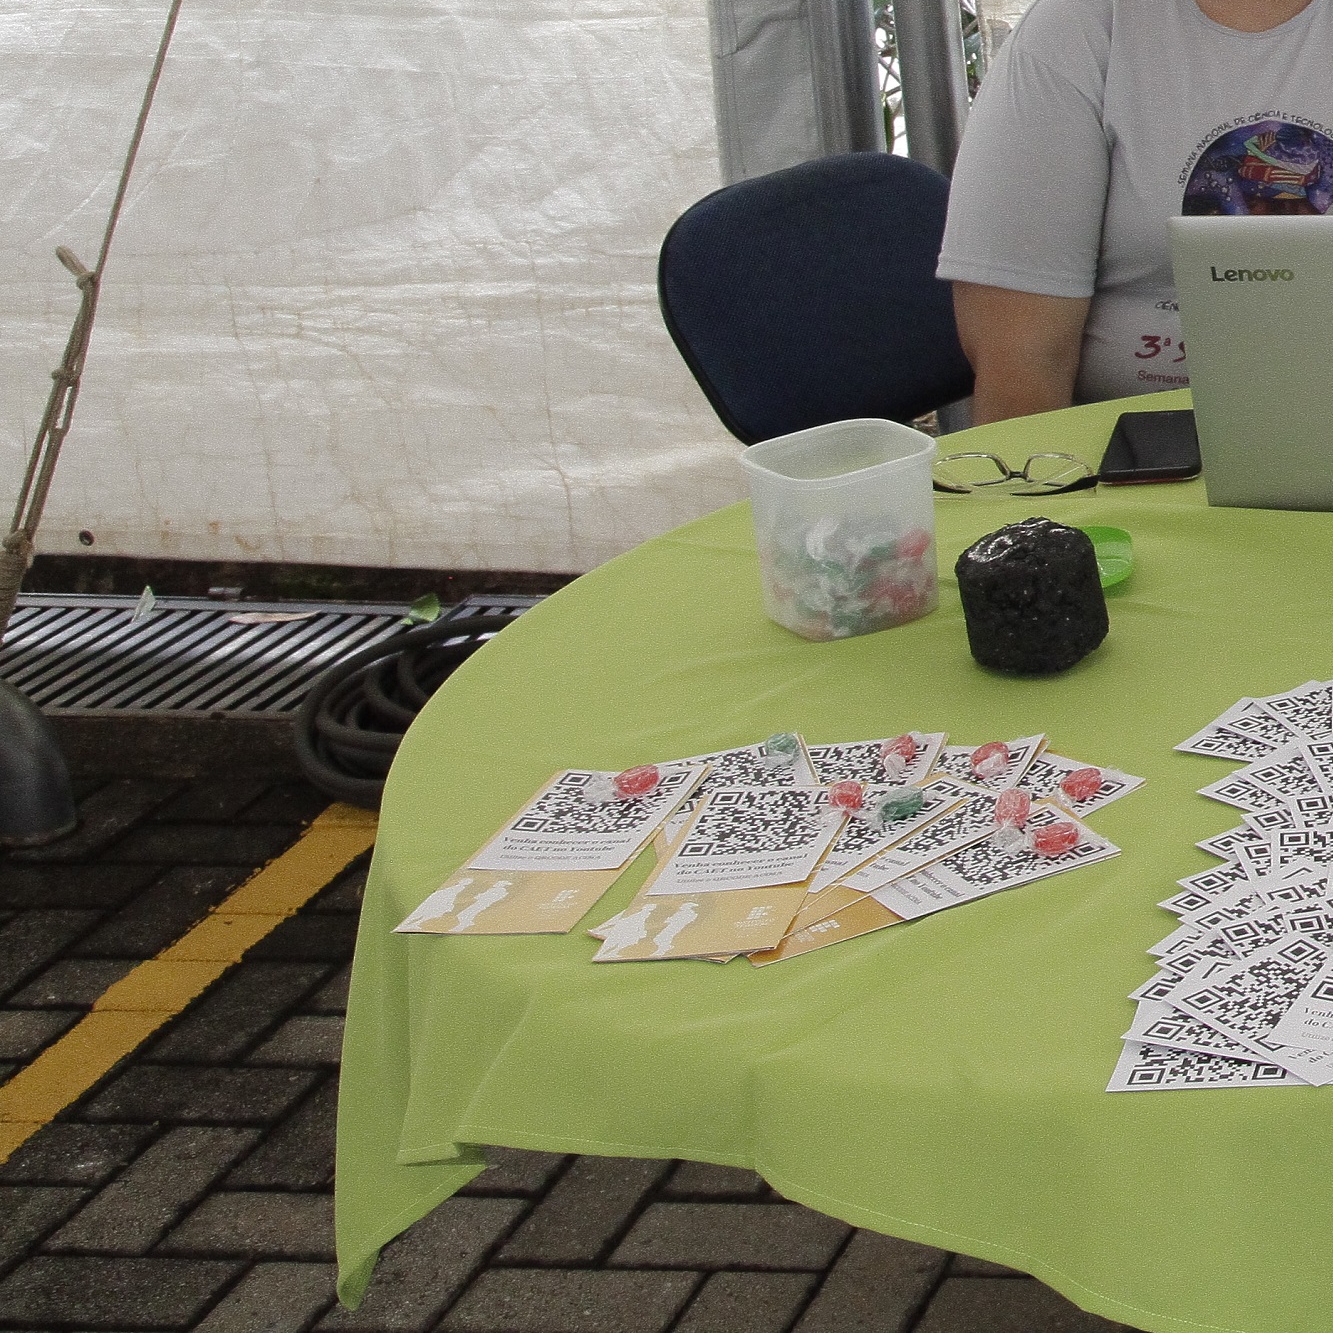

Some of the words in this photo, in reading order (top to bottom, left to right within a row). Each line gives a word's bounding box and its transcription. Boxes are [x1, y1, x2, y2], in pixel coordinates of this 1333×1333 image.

[1178, 150, 1198, 188] SEMANA
[1196, 122, 1233, 153] NACIONAL
[1210, 266, 1295, 282] Lenovo
[1136, 369, 1190, 386] Semana
[1304, 1018, 1320, 1026] do
